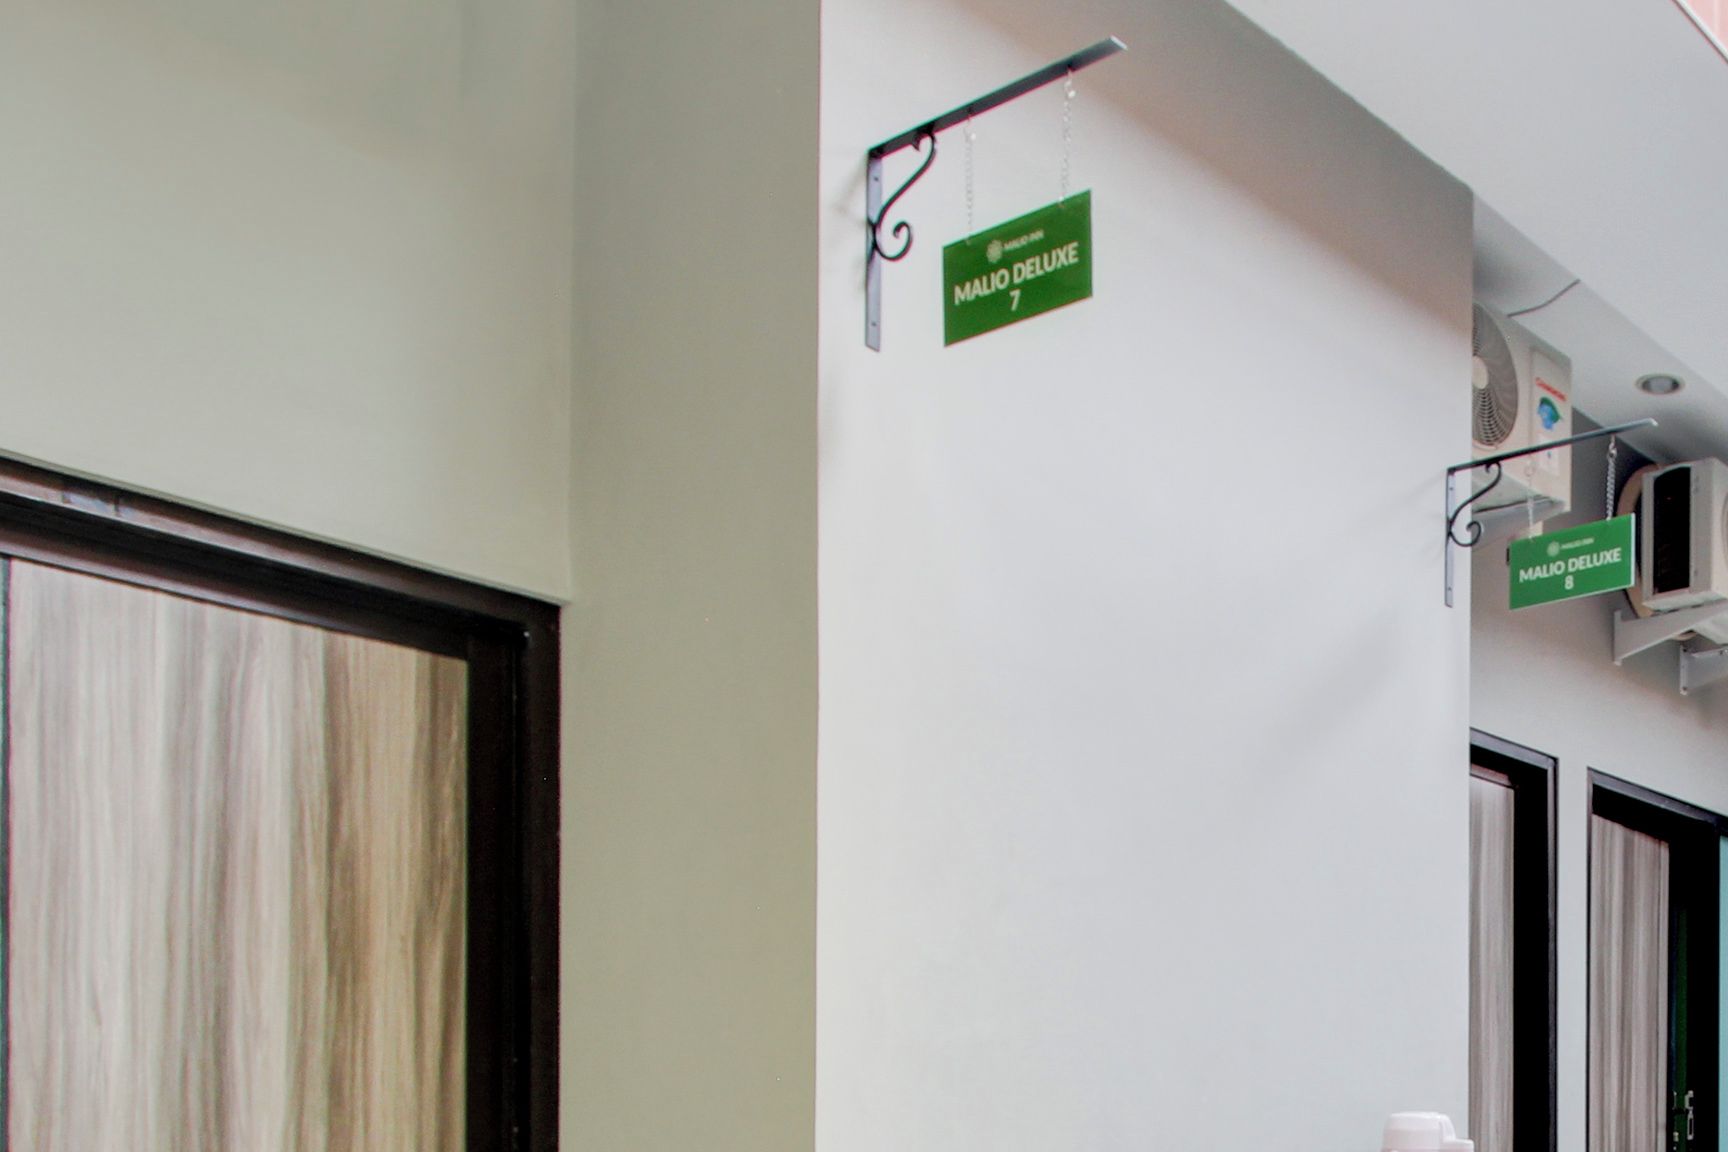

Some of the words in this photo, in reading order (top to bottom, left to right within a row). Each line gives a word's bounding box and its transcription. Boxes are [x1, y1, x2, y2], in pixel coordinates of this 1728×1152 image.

[954, 268, 1010, 306] MALIO
[1012, 241, 1079, 284] DELUXE
[1009, 288, 1021, 311] 7
[1519, 560, 1566, 583] MALIO
[1567, 547, 1622, 573] DELUXE
[1564, 574, 1574, 590] 8
